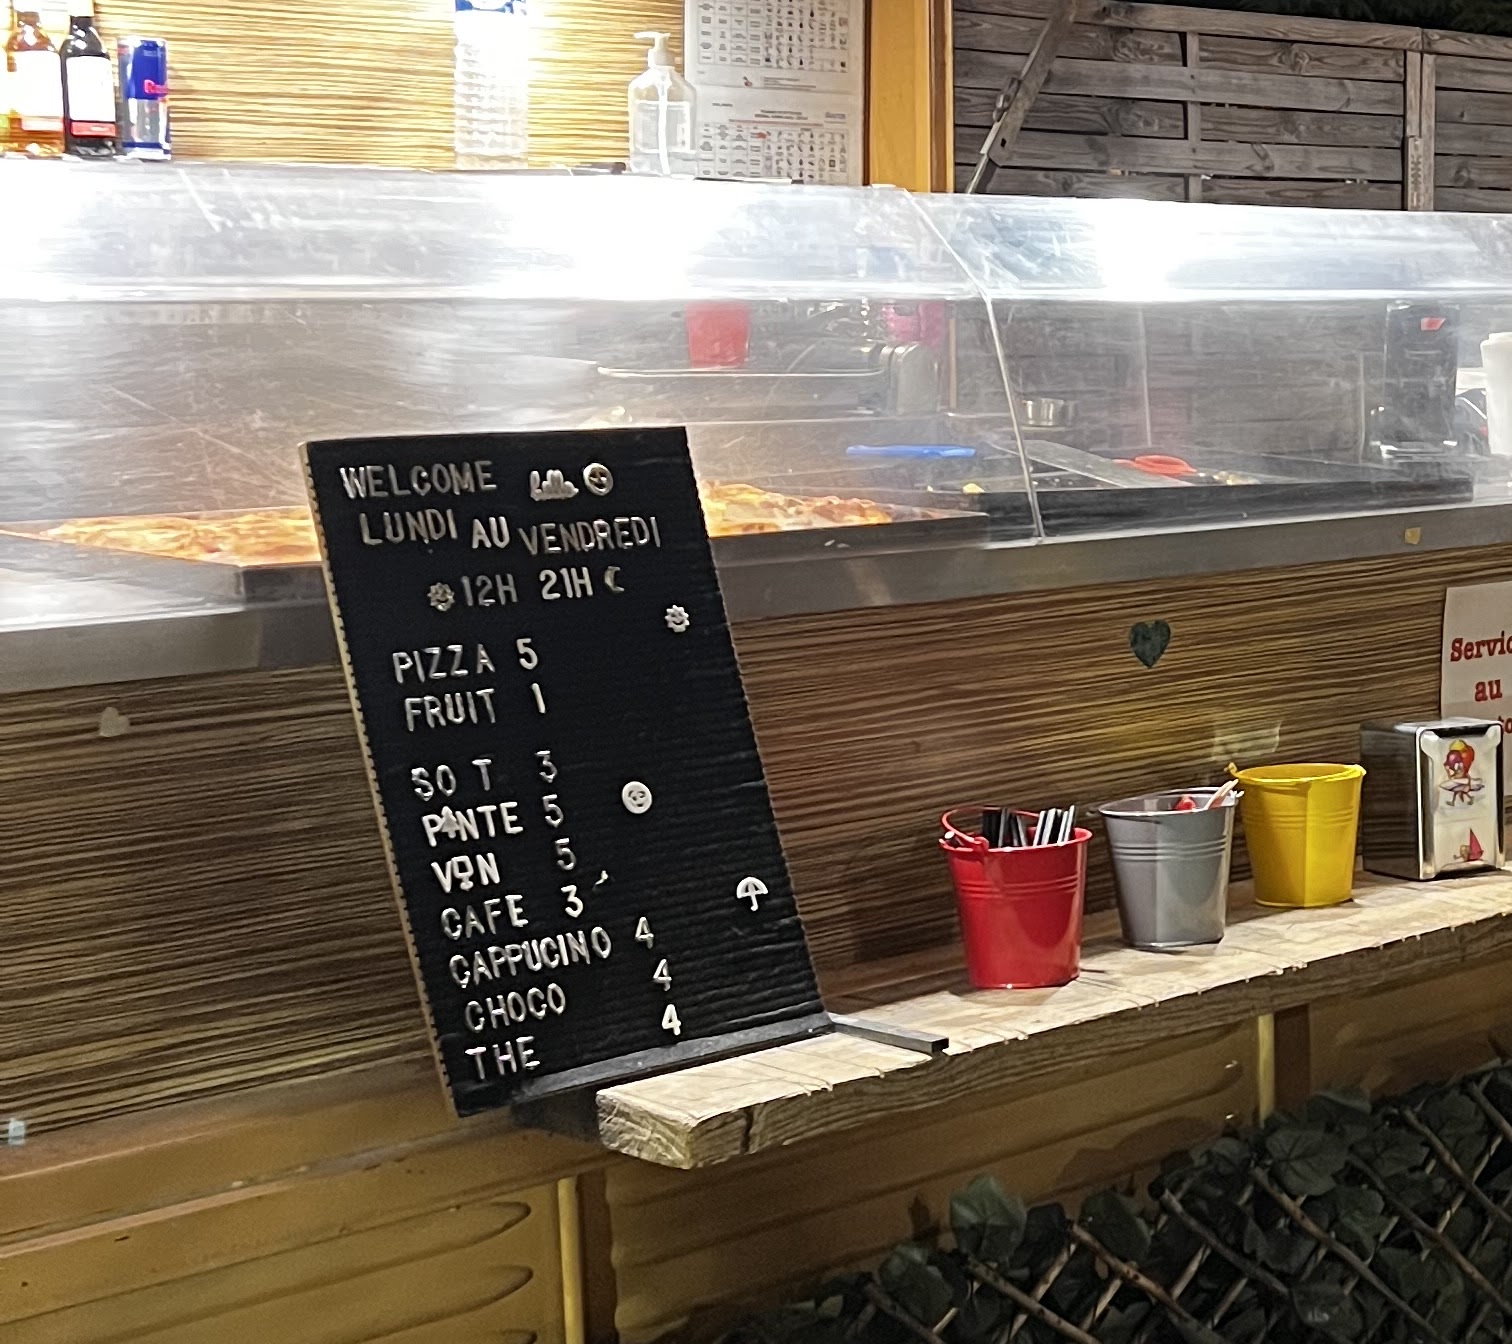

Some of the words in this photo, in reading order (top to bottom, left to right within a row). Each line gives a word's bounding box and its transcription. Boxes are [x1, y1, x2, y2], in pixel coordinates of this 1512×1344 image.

[339, 460, 498, 499] WELCOME
[359, 509, 458, 546] LUNDI
[471, 516, 510, 549] AU
[517, 516, 661, 556] VENDREDI
[461, 573, 518, 607] 12H
[539, 566, 593, 600] 21H
[392, 643, 496, 684] PIZZA
[516, 637, 538, 670] 5
[404, 688, 496, 732] FRUIT
[1474, 679, 1503, 702] au
[534, 750, 558, 783] 3
[541, 793, 564, 828] 5
[554, 837, 577, 871] 5
[440, 894, 529, 941] CAFE
[560, 884, 584, 918] 3
[448, 926, 612, 989] CAPPUCINO
[635, 916, 655, 950] 4
[465, 982, 566, 1033] CHOCO
[653, 958, 673, 992] 4
[464, 1035, 541, 1080] THE
[661, 1003, 682, 1036] 4
